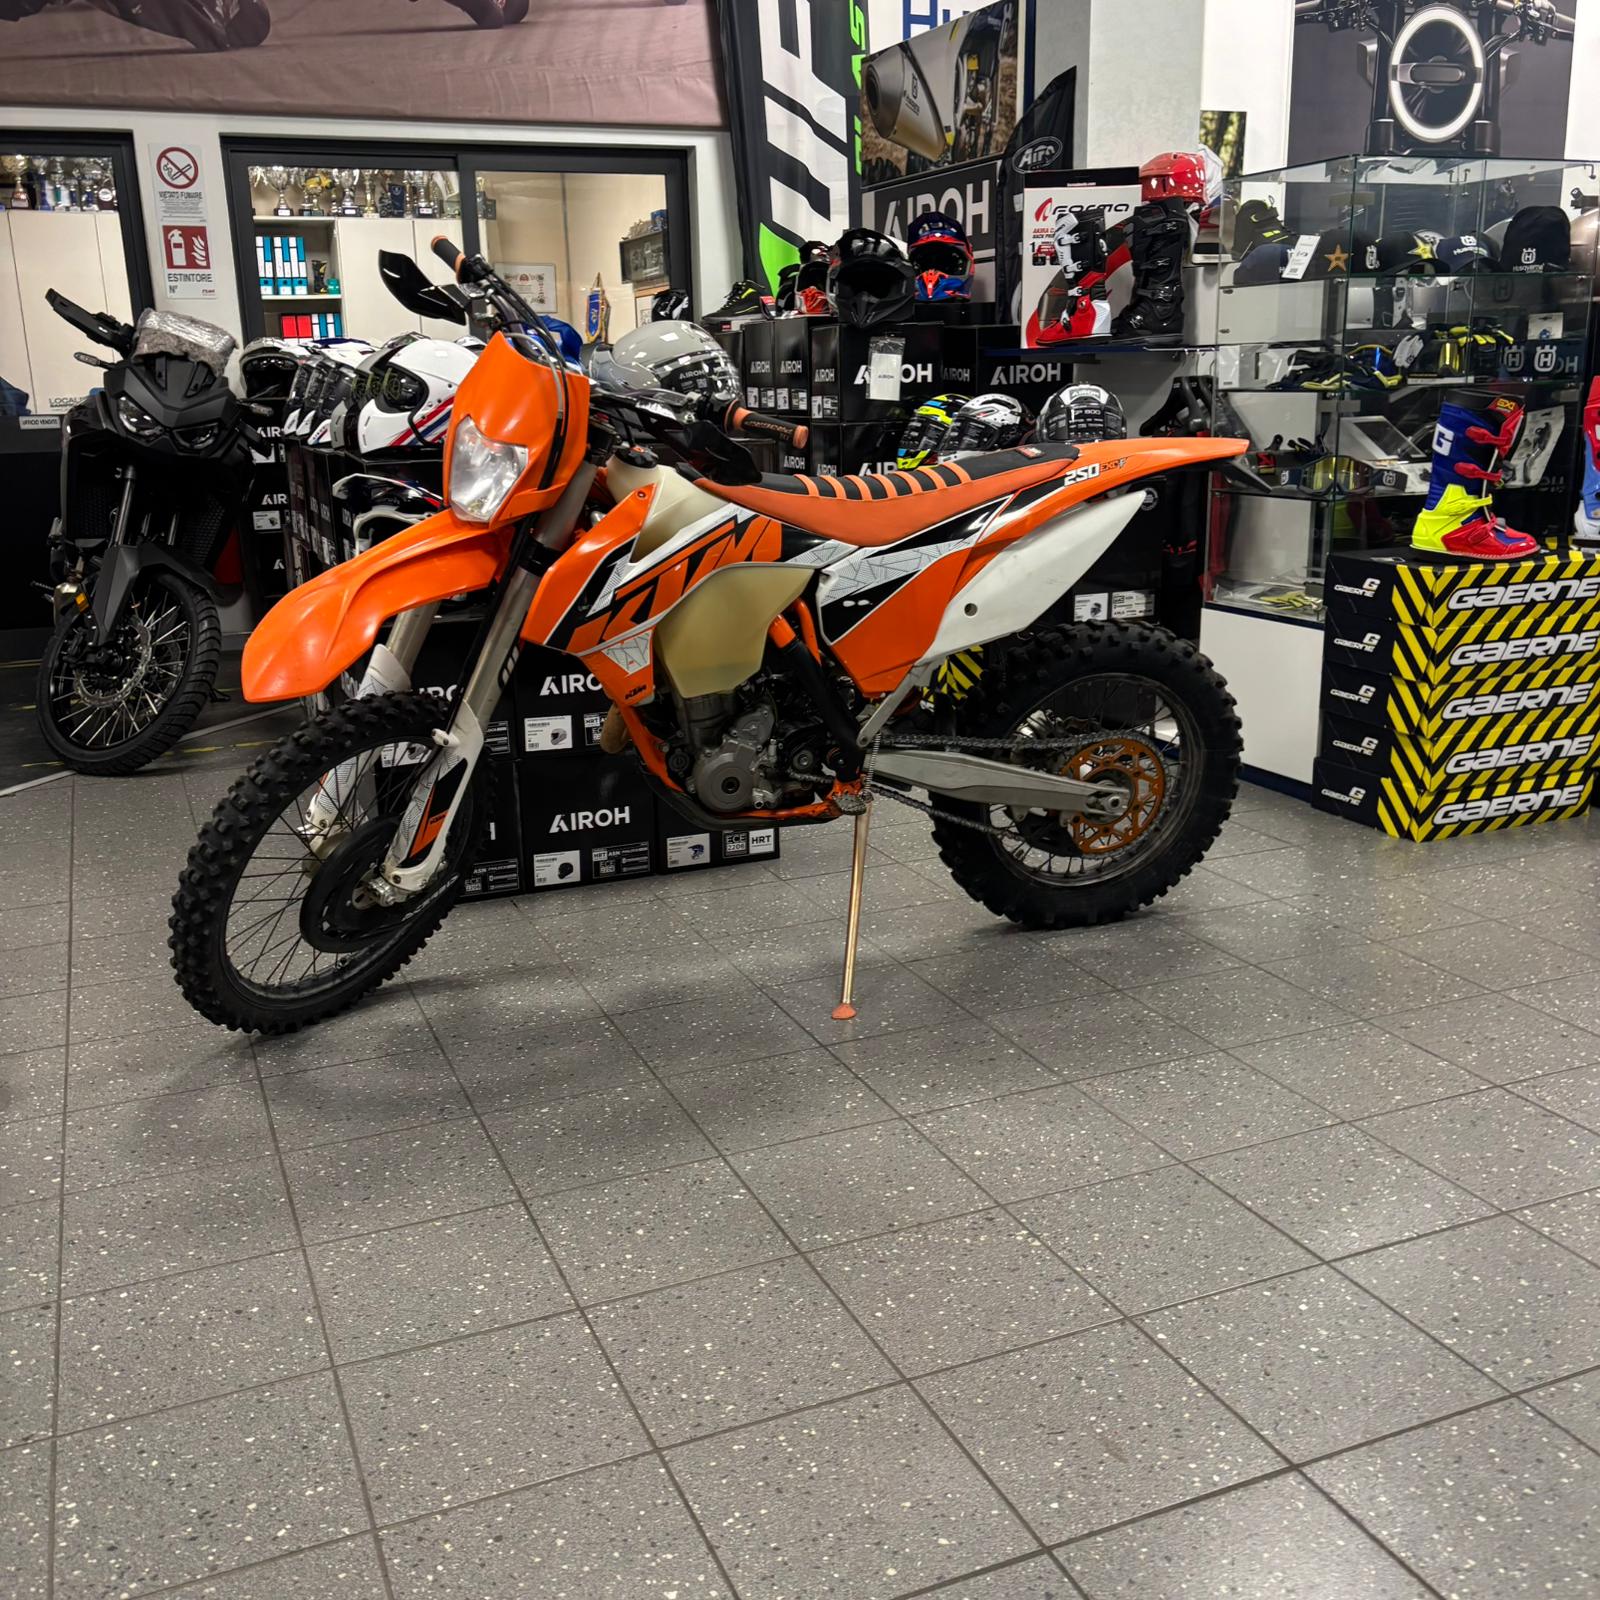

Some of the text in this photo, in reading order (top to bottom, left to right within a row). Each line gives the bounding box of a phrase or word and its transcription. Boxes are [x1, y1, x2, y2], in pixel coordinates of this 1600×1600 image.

[180, 191, 203, 200] FUMARE
[167, 273, 213, 283] ESTINTORE
[750, 361, 771, 374] AIROH
[780, 360, 802, 374] AIROH
[943, 367, 971, 382] AIROH
[990, 363, 1062, 386] AIROH
[814, 368, 835, 382] AIROH
[257, 426, 282, 438] AIR
[783, 455, 806, 470] AIROH
[817, 463, 837, 477] AIROH
[1064, 463, 1100, 487] 250
[261, 493, 288, 505] AIR
[566, 515, 783, 650] KTM
[1448, 577, 1600, 610] GAERNE
[1450, 630, 1600, 666] GAERNE
[540, 673, 603, 697] AIRO
[625, 684, 648, 700] KTM
[1442, 683, 1594, 720] GAERNE
[1446, 734, 1595, 774] GAERNE
[1433, 784, 1584, 825] GAERNE
[548, 805, 631, 834] AIROH
[726, 832, 748, 844] ECE
[751, 835, 772, 845] HRT
